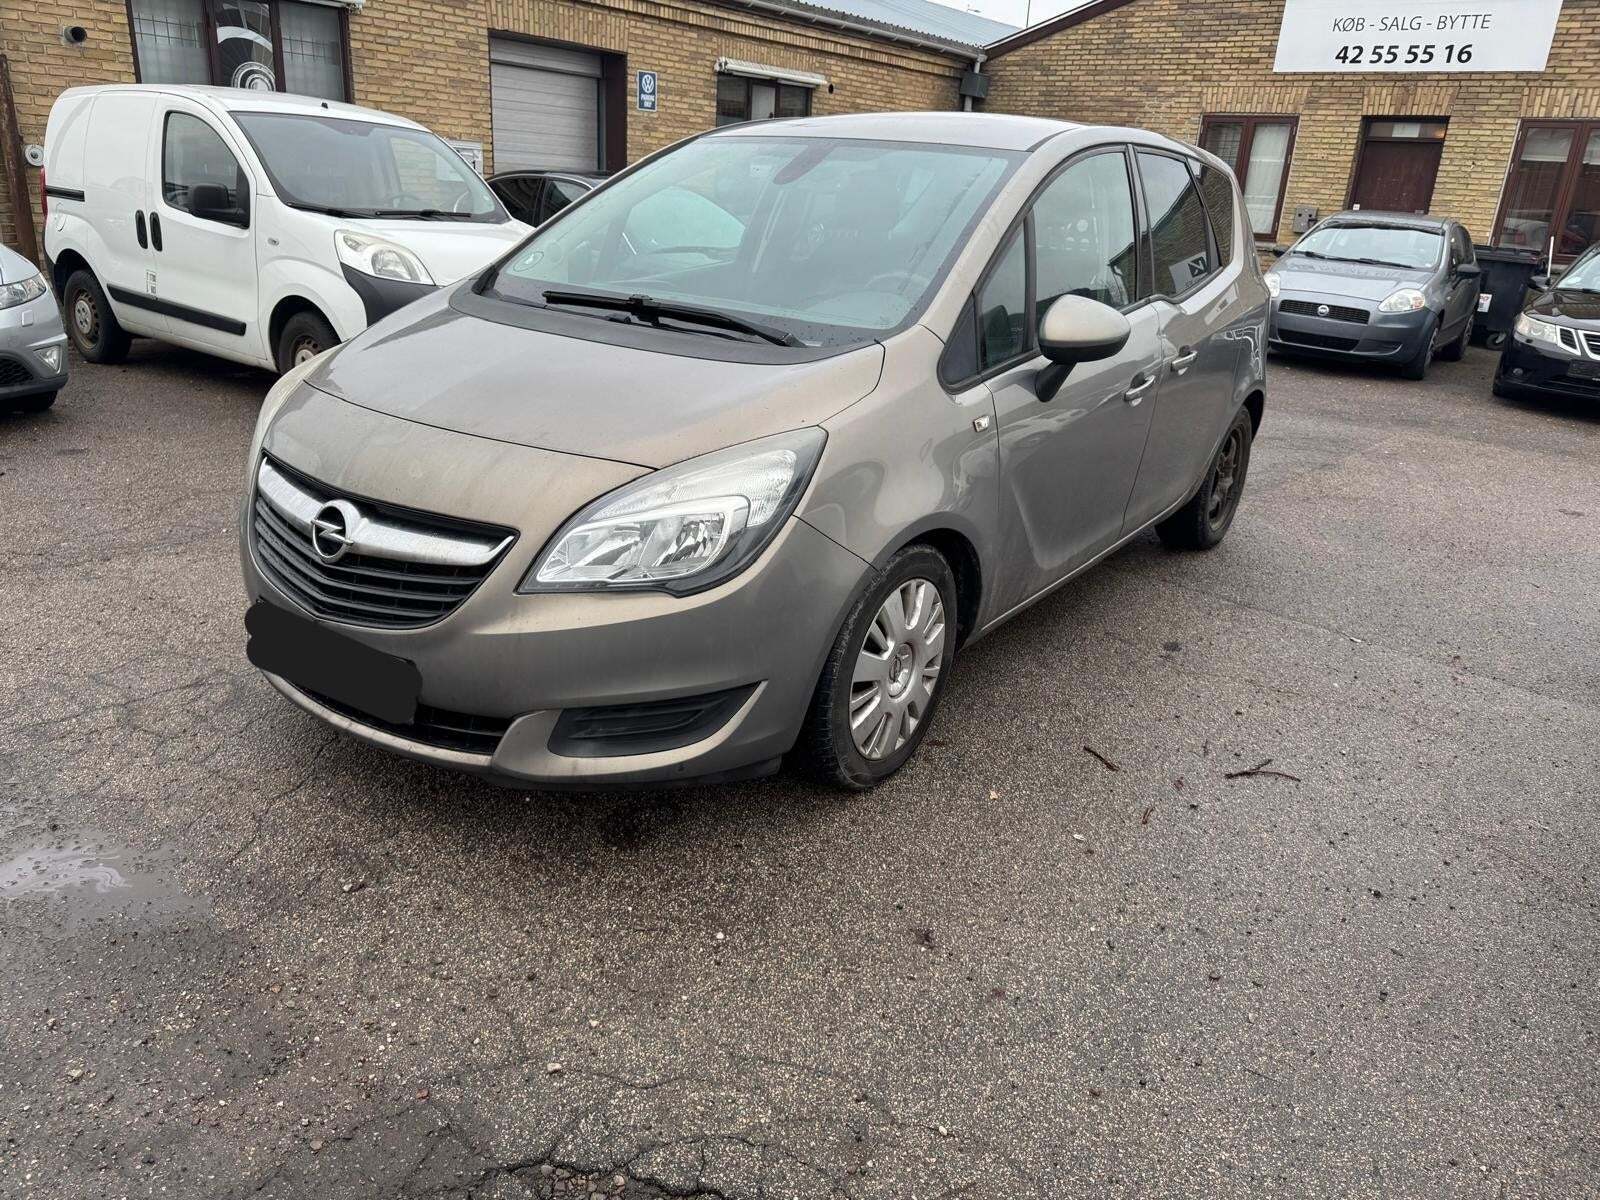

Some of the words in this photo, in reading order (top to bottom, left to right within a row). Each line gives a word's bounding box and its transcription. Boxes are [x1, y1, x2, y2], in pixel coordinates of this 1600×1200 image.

[1332, 16, 1365, 32] KØB
[1379, 15, 1422, 32] SALG
[1436, 14, 1492, 30] BYTTE
[1335, 45, 1364, 64] 42
[1369, 45, 1399, 64] 55
[1404, 44, 1435, 64] 55
[1444, 44, 1473, 64] 16
